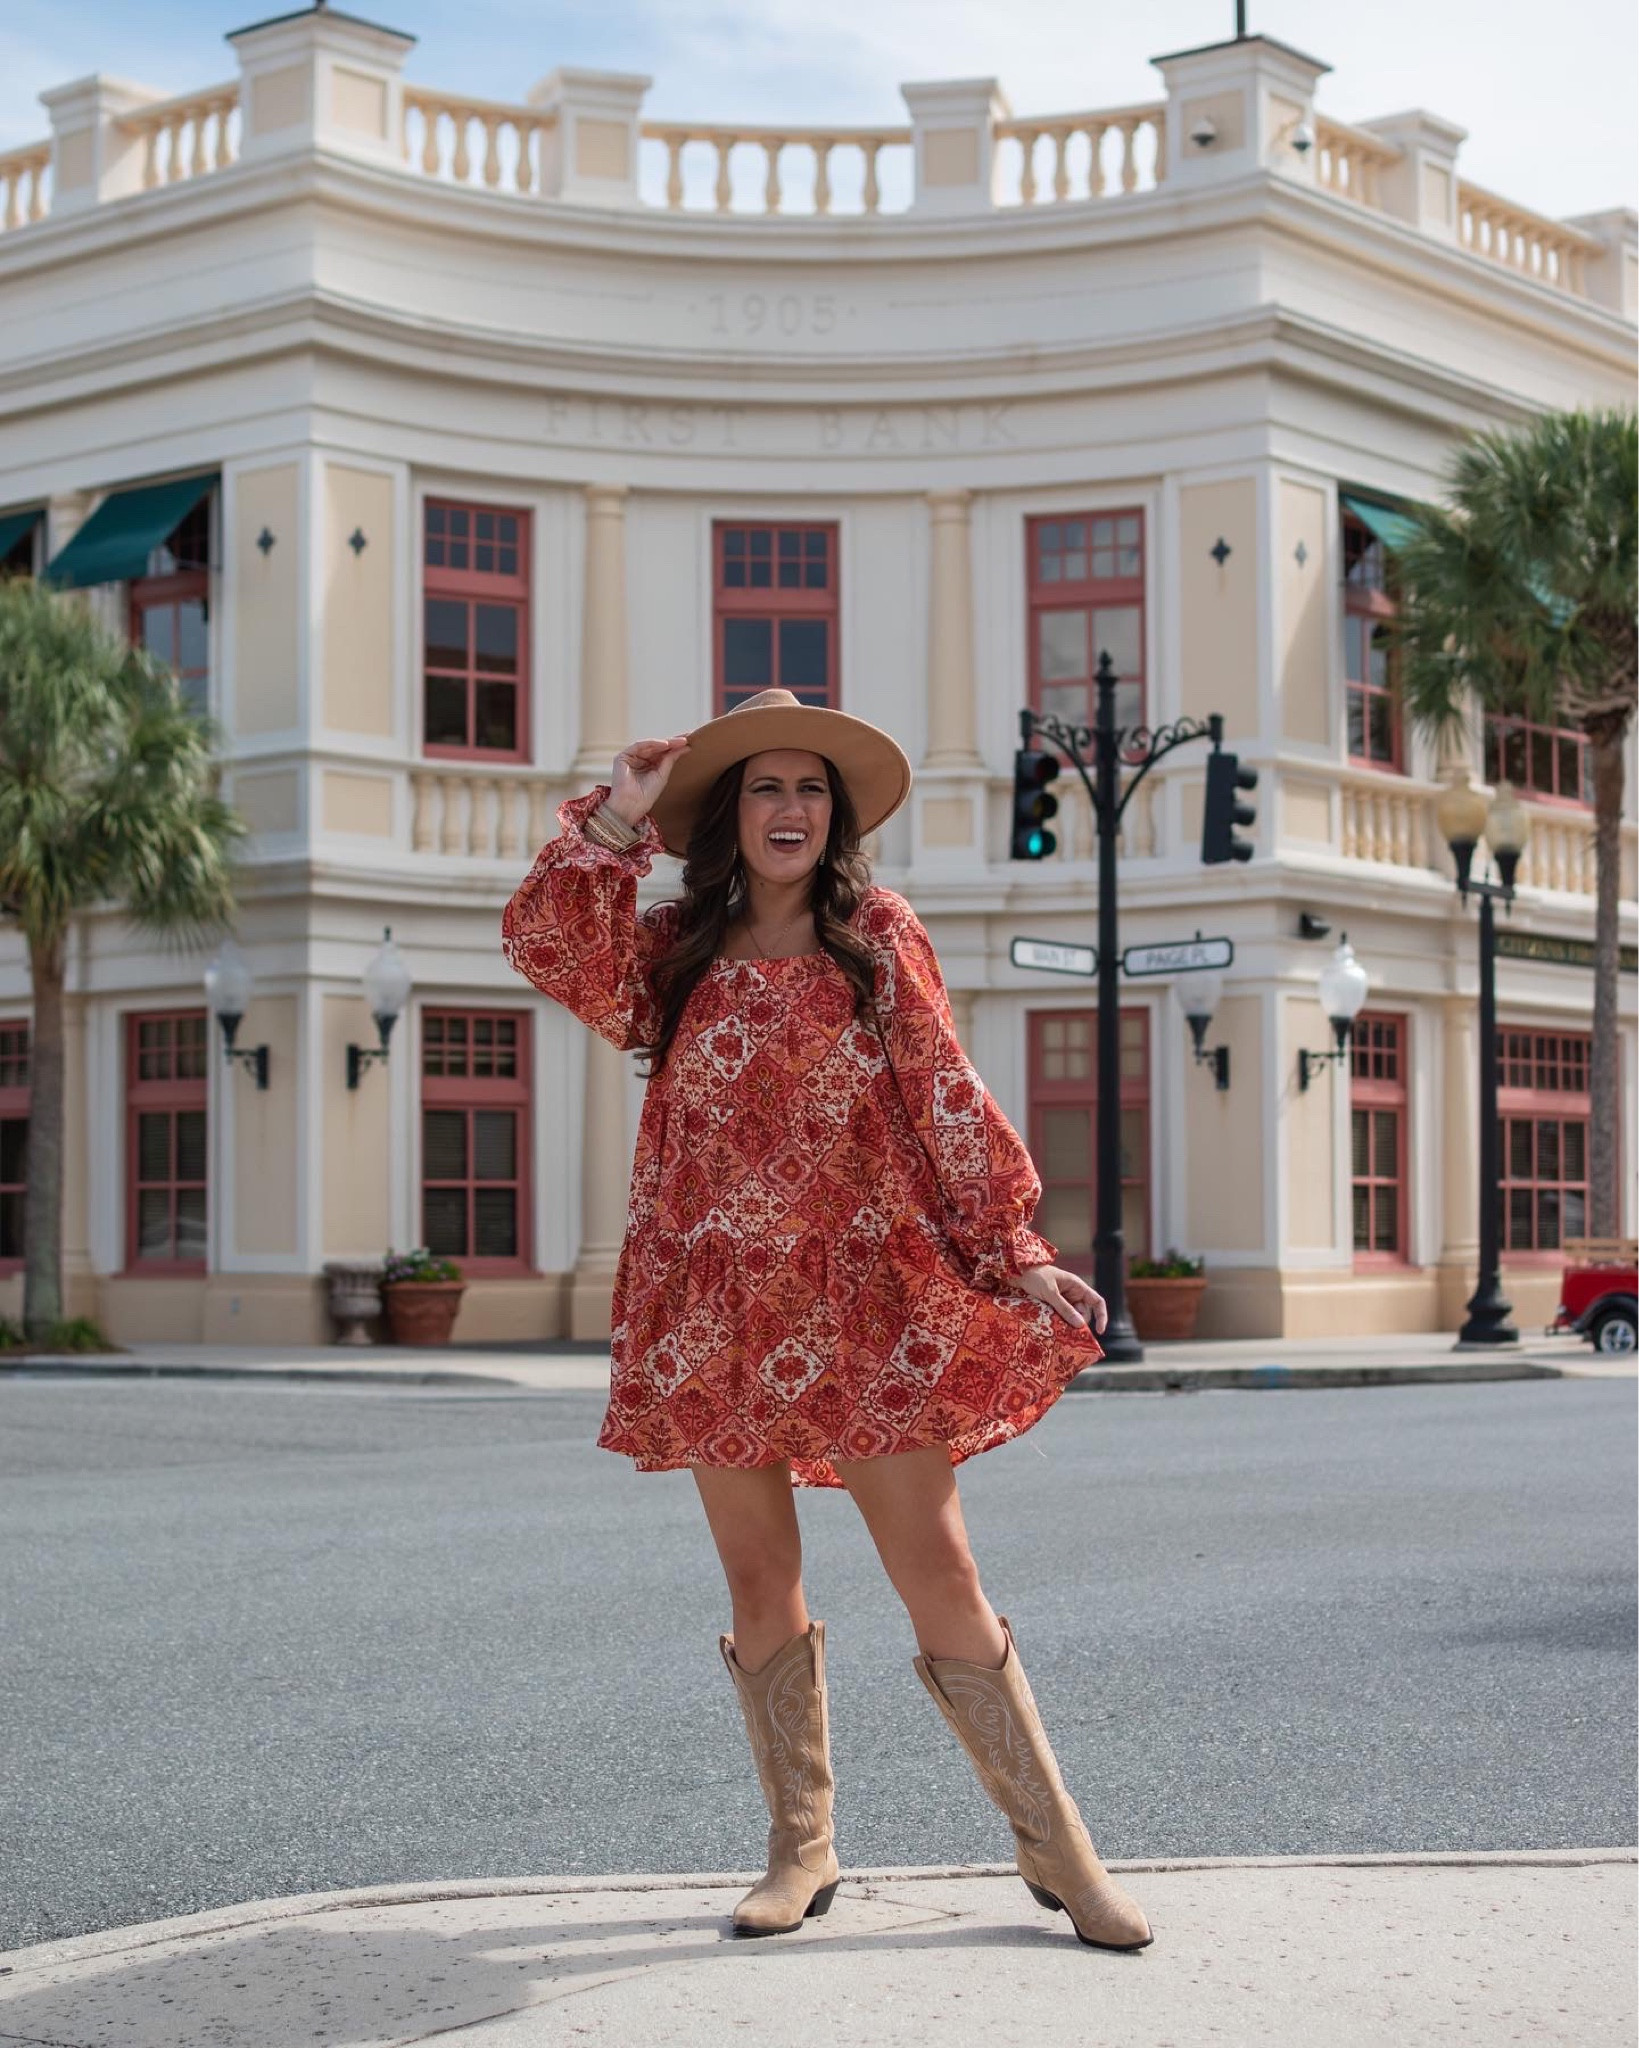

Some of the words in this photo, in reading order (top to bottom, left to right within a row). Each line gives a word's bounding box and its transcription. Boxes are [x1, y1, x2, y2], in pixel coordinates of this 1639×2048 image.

[707, 293, 838, 337] 1905
[541, 395, 746, 448] FIRST
[815, 401, 1019, 451] BANK
